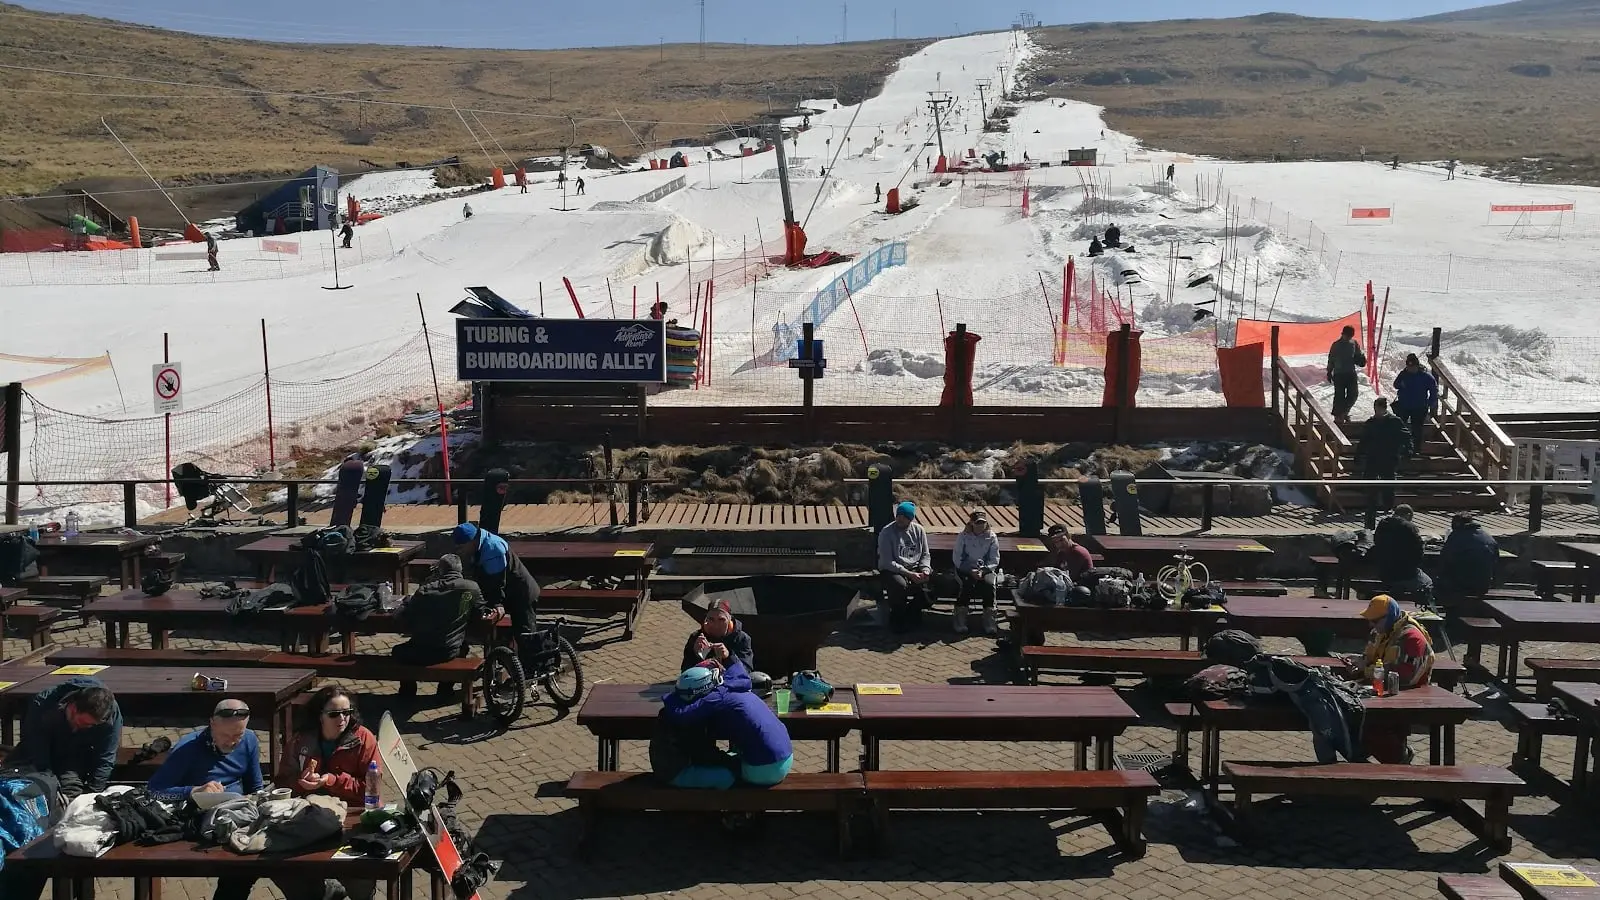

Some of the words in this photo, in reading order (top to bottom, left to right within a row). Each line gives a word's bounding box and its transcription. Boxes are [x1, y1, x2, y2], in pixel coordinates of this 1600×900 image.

[464, 326, 529, 343] TUBING
[535, 326, 548, 343] &
[466, 352, 597, 369] BUMBOARDING
[601, 353, 655, 369] ALLEY
